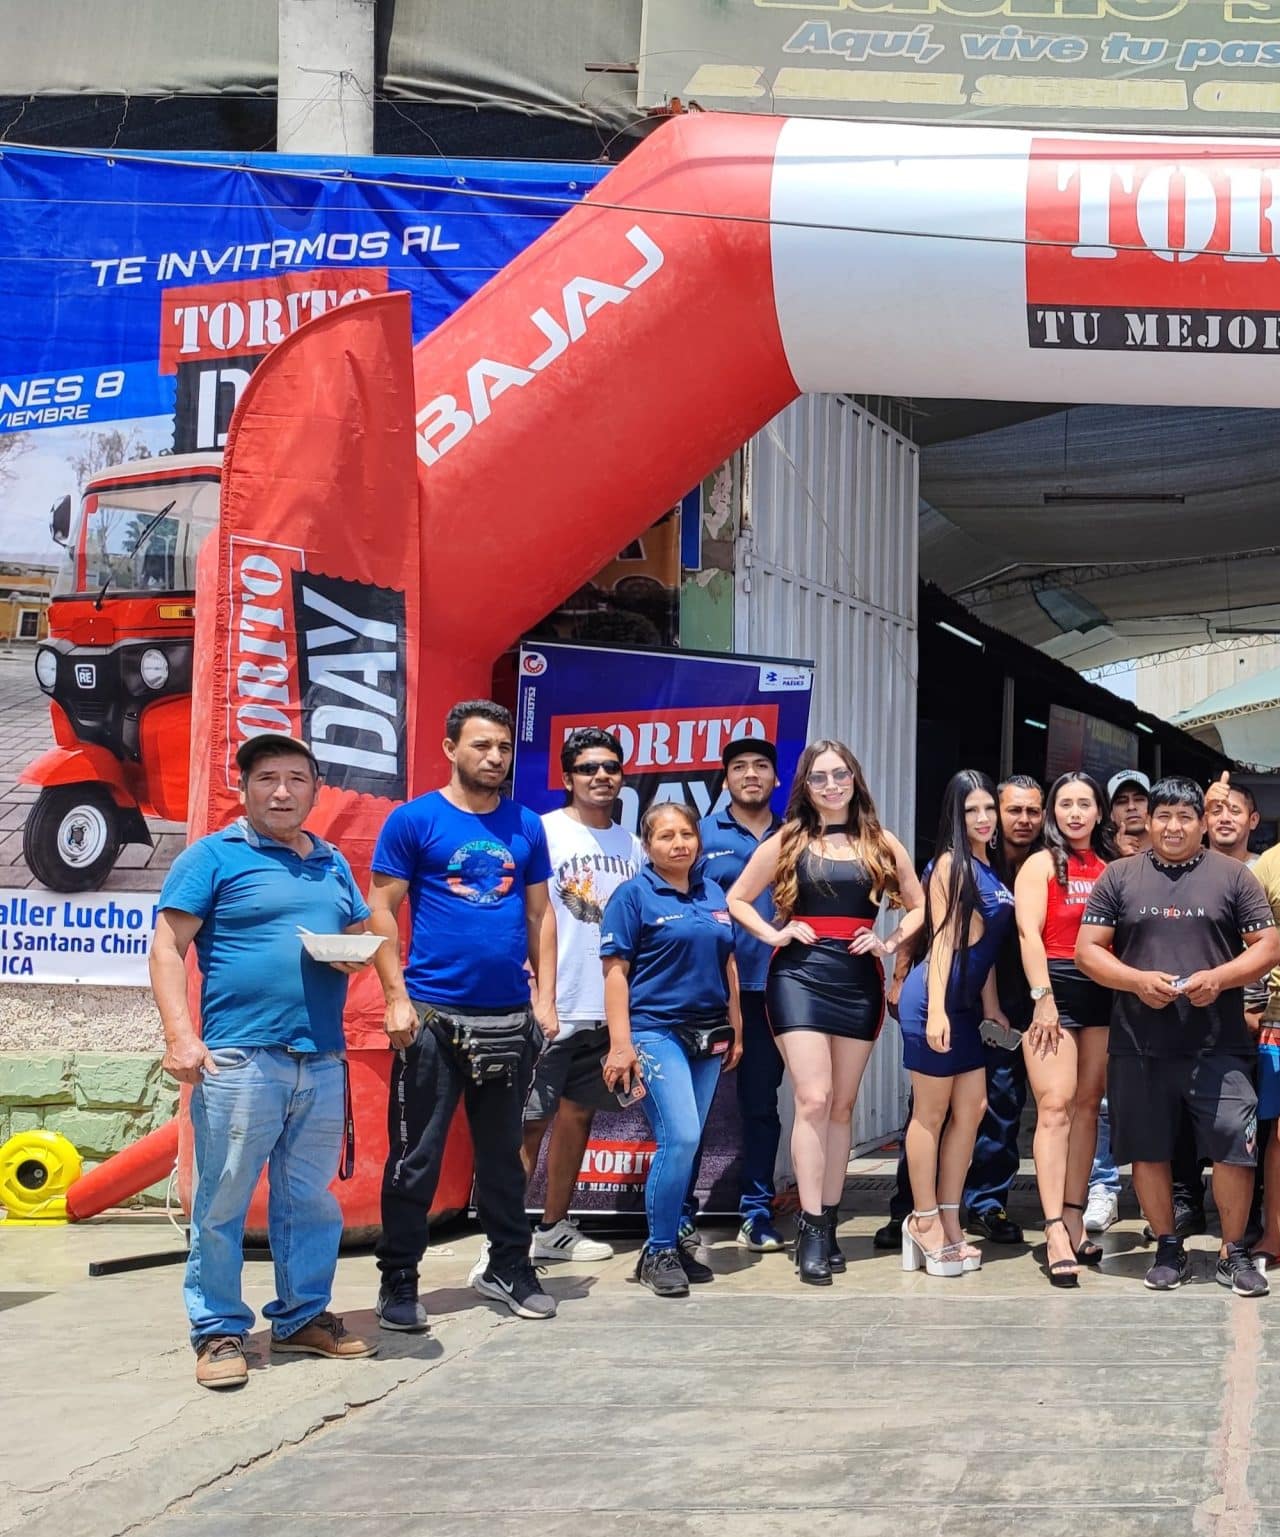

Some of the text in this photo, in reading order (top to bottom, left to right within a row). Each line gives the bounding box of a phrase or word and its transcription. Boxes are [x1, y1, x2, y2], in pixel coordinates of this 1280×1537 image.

[784, 20, 945, 64] Aquí,
[960, 25, 1088, 61] vive
[1100, 32, 1173, 65] tu
[91, 225, 461, 288] TE INVITAMOS AL
[173, 287, 375, 355] TORIT
[1036, 309, 1101, 345] TU
[415, 224, 666, 467] BAJAJ
[95, 370, 126, 399] 8
[236, 554, 293, 748] ORITO
[302, 584, 399, 776] DAY
[563, 716, 768, 768] ORIT
[63, 901, 144, 930] Lucho
[1139, 906, 1206, 919] JORDAN
[1, 955, 34, 976] ICA
[13, 931, 96, 953] Santana
[101, 933, 148, 955] Chiri
